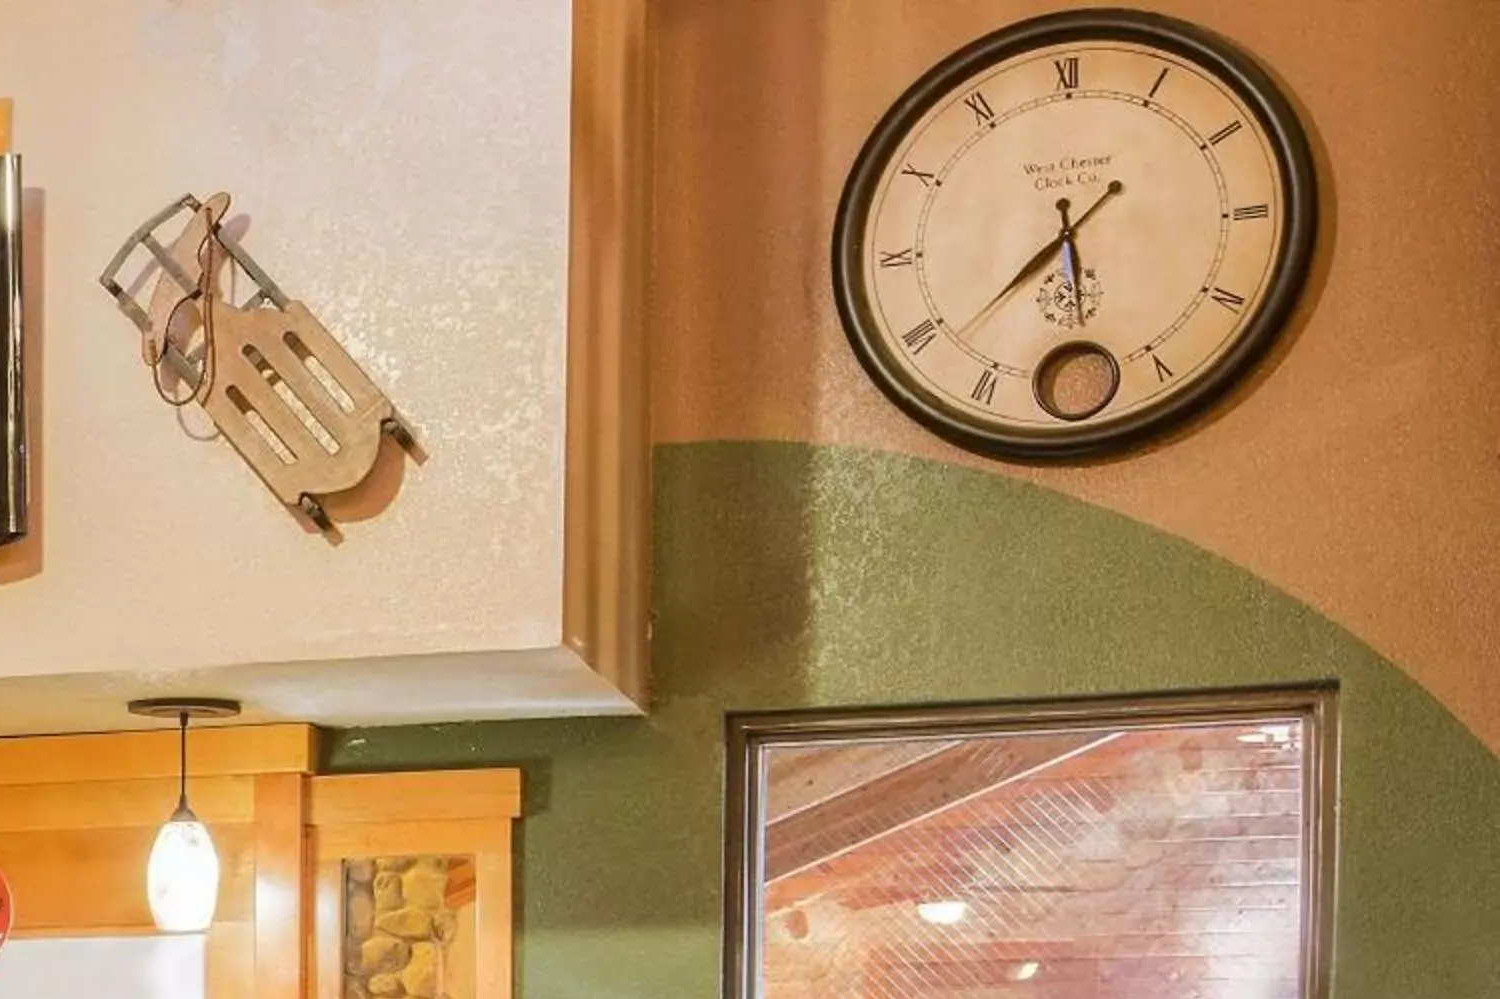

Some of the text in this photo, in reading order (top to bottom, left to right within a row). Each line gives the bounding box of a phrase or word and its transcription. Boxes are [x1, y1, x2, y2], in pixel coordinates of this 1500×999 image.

[1053, 57, 1079, 91] XII
[964, 91, 995, 126] XI
[1208, 119, 1243, 146] II
[901, 163, 935, 188] X
[1022, 154, 1112, 176] West Chester
[1034, 176, 1073, 191] Clock
[1233, 204, 1269, 221] III
[880, 248, 913, 268] IX
[902, 319, 937, 355] VIII
[1152, 353, 1173, 383] V
[971, 369, 998, 405] VII
